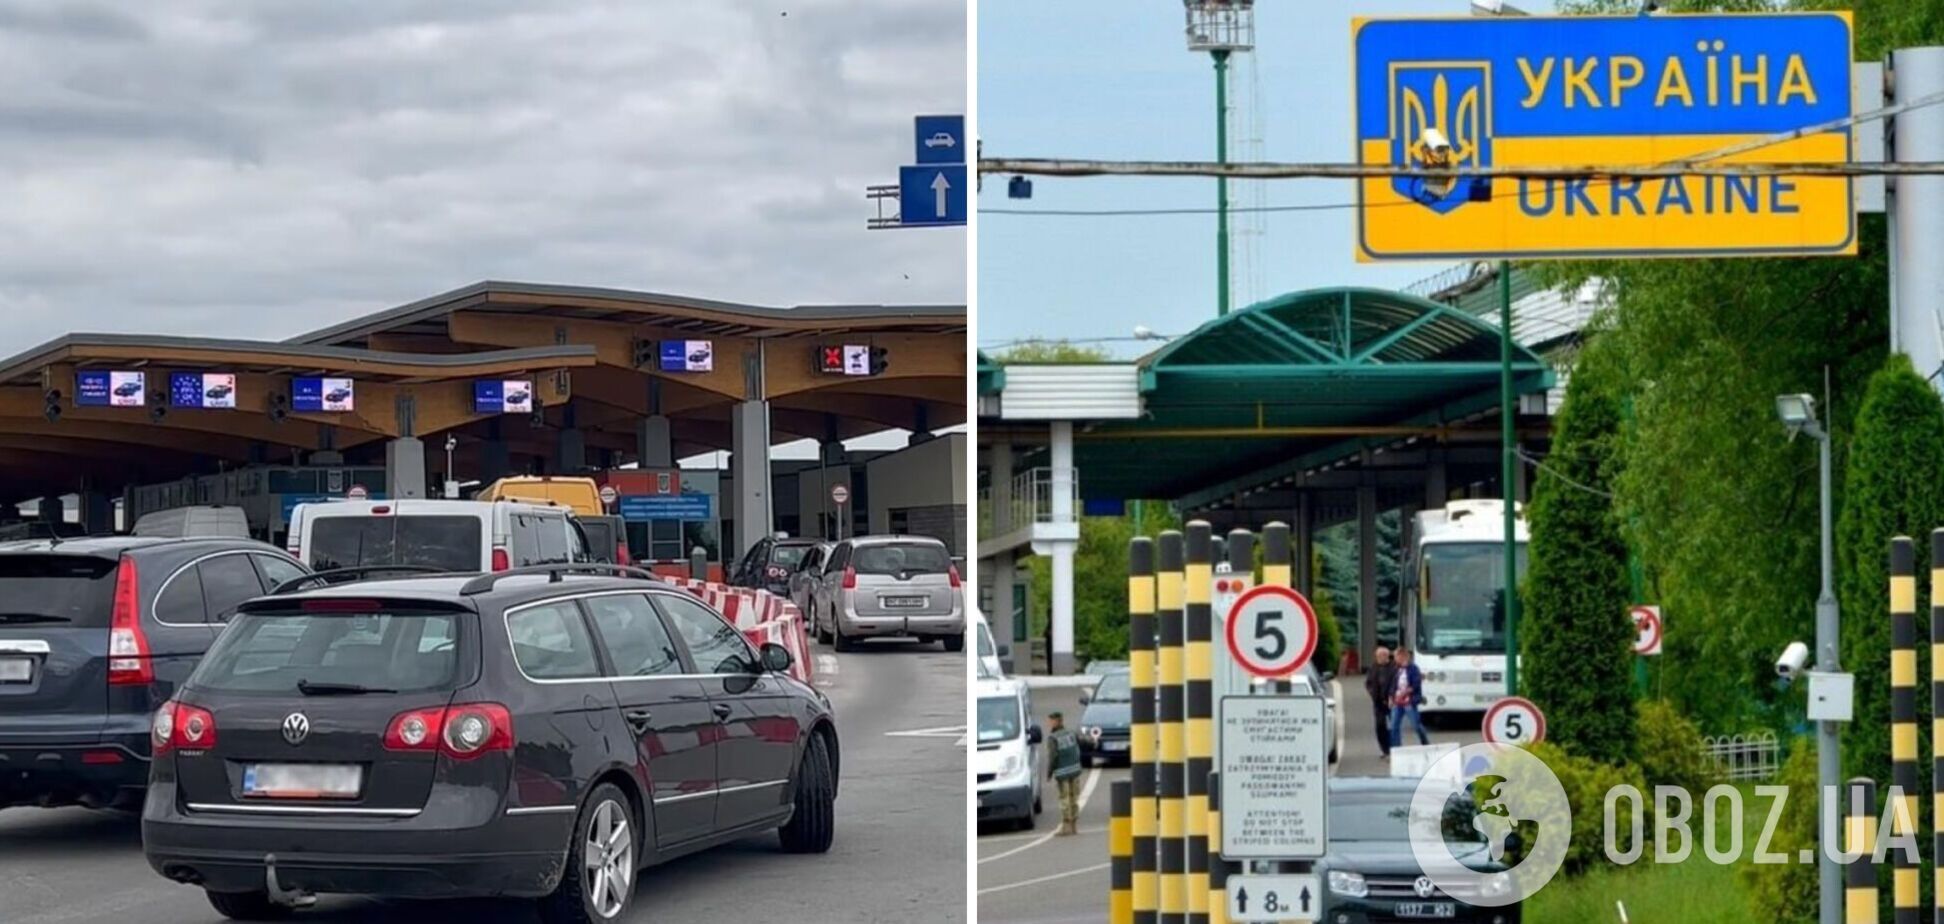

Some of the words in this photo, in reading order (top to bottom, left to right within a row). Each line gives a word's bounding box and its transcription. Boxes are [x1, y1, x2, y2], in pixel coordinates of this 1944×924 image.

[1516, 40, 1818, 109] УКРАЇНА
[1517, 171, 1800, 218] UKRAINE
[1254, 610, 1287, 661] 5
[1505, 713, 1522, 740] 5
